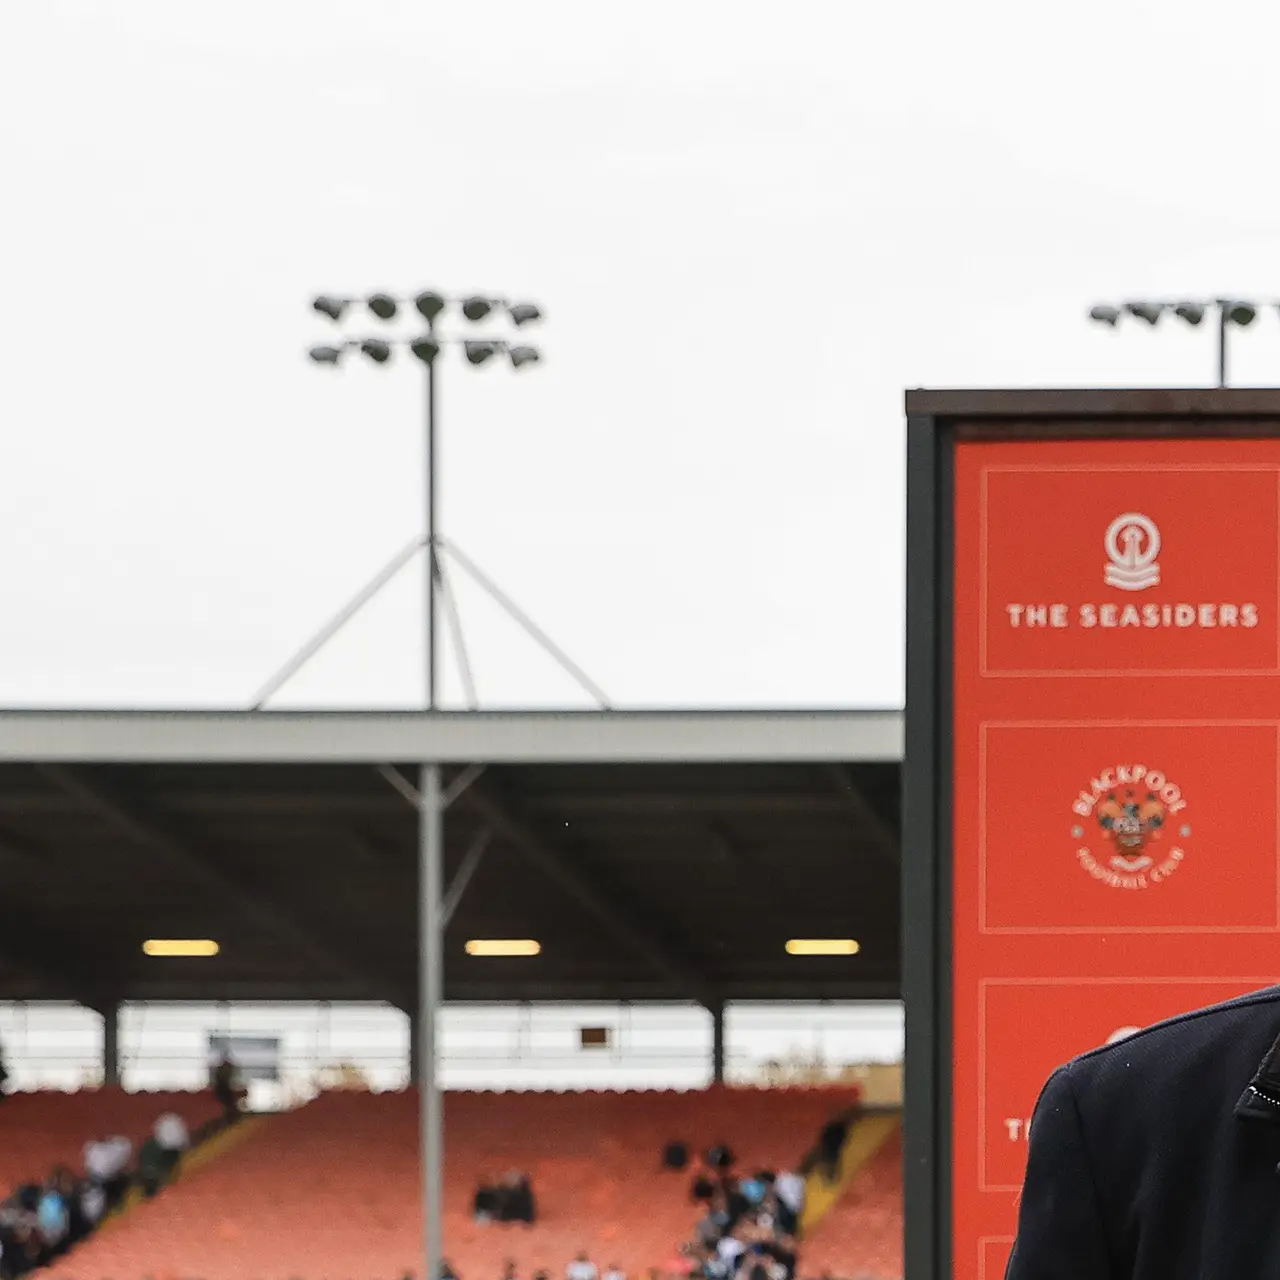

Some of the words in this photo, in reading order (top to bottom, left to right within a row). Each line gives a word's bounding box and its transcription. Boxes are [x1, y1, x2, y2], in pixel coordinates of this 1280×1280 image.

[1006, 603, 1069, 628] THE
[1079, 602, 1258, 629] SEASIDERS
[1072, 764, 1187, 817] BLACKPOOL
